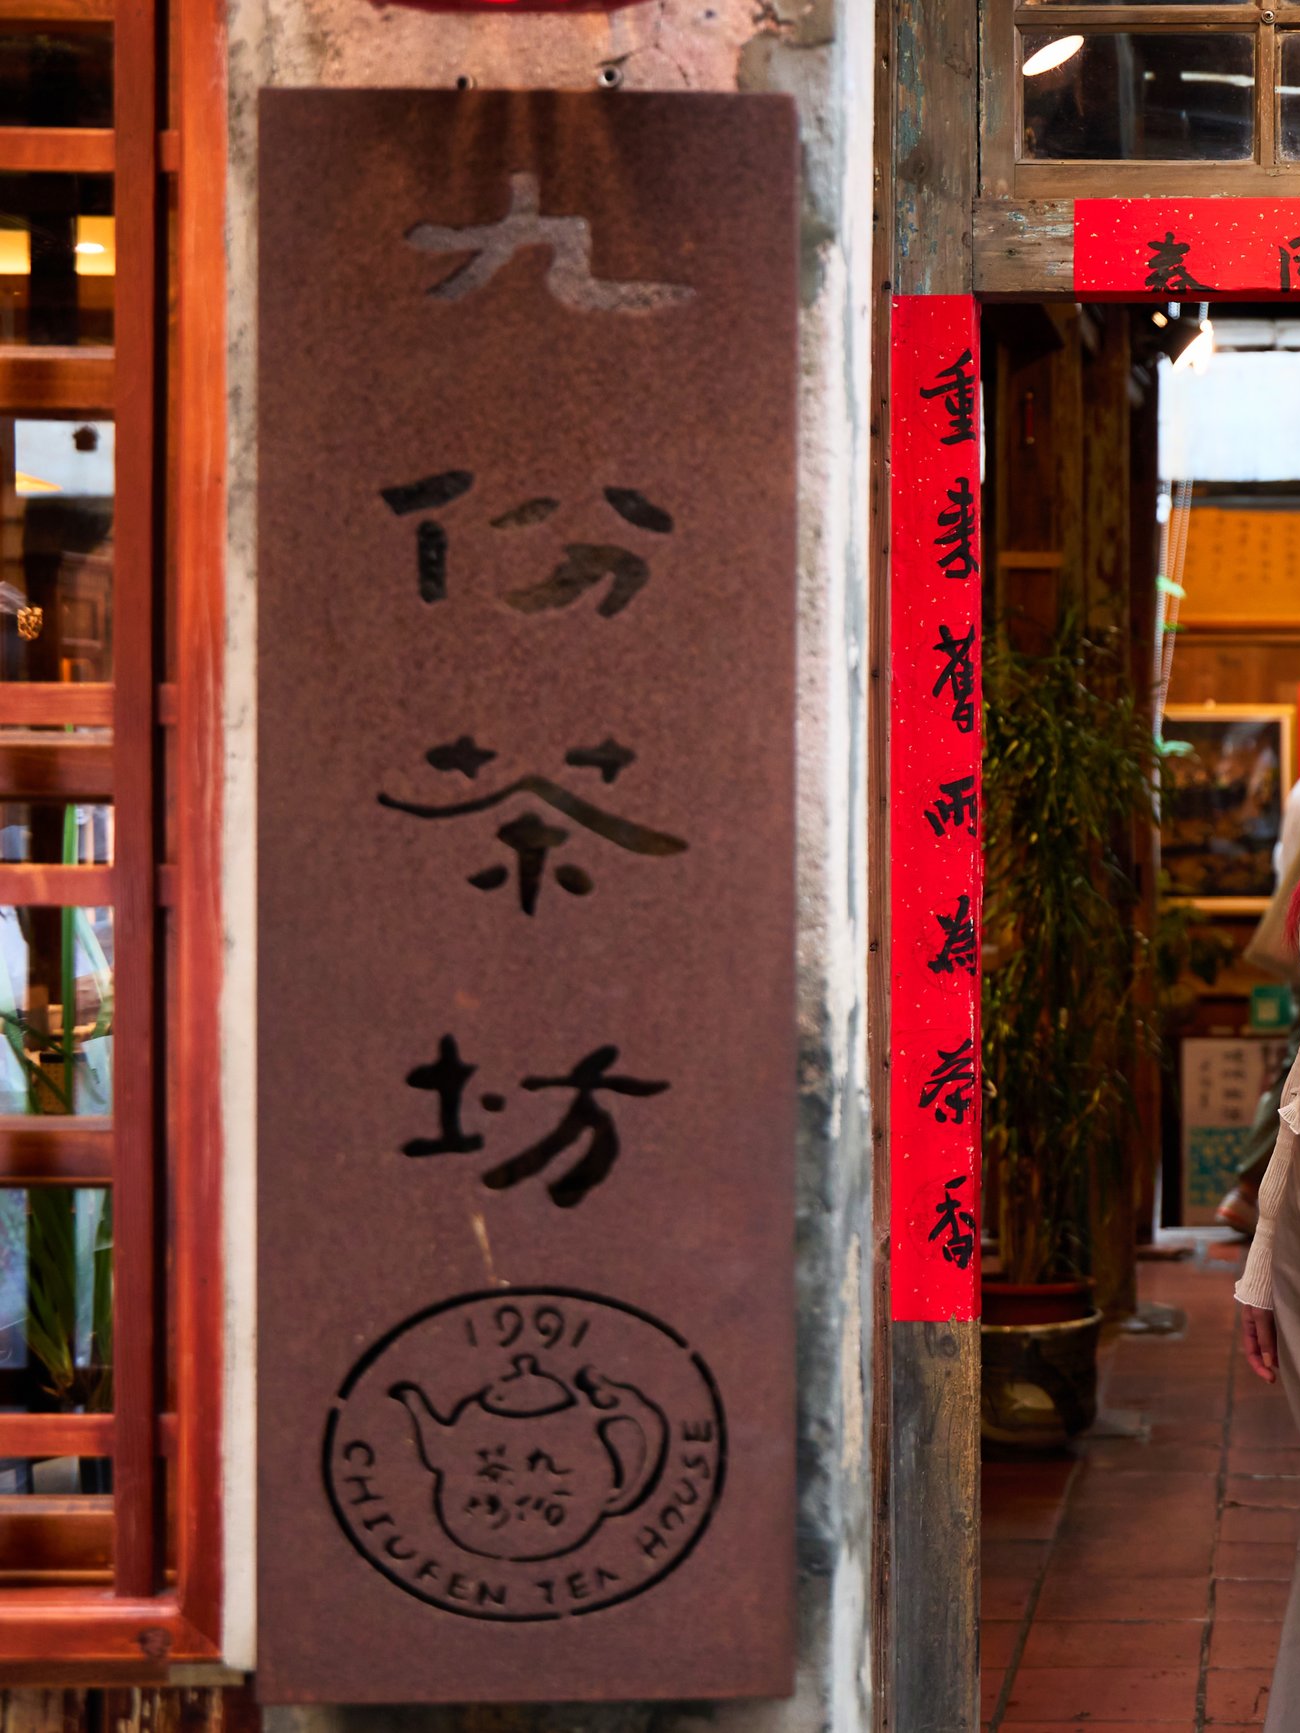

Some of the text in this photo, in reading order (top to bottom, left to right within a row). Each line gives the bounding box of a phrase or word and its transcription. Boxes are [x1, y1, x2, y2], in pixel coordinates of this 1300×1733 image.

[376, 170, 697, 1208] 九份茶坊
[464, 1304, 590, 1348] 1991
[536, 1567, 620, 1604] TEA
[636, 1419, 713, 1560] HOUSE
